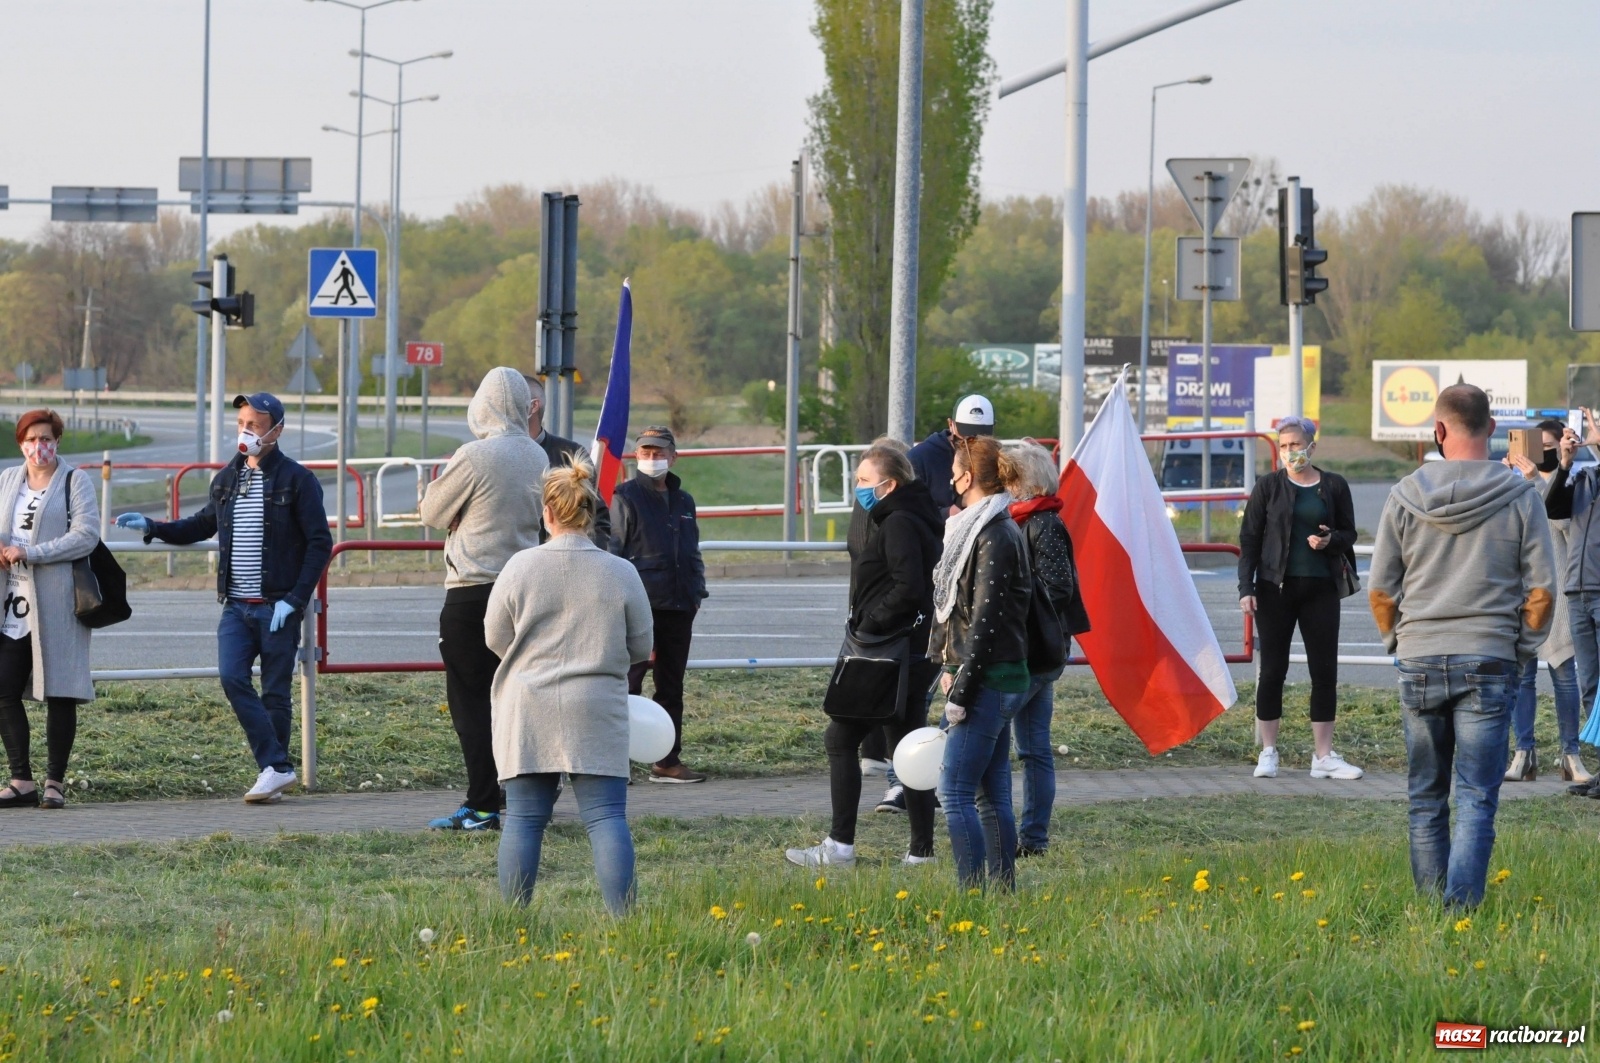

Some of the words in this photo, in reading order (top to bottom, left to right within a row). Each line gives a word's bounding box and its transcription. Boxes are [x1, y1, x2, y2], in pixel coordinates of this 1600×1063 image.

[415, 346, 435, 362] 78
[1218, 398, 1231, 407] od
[1495, 394, 1521, 405] min
